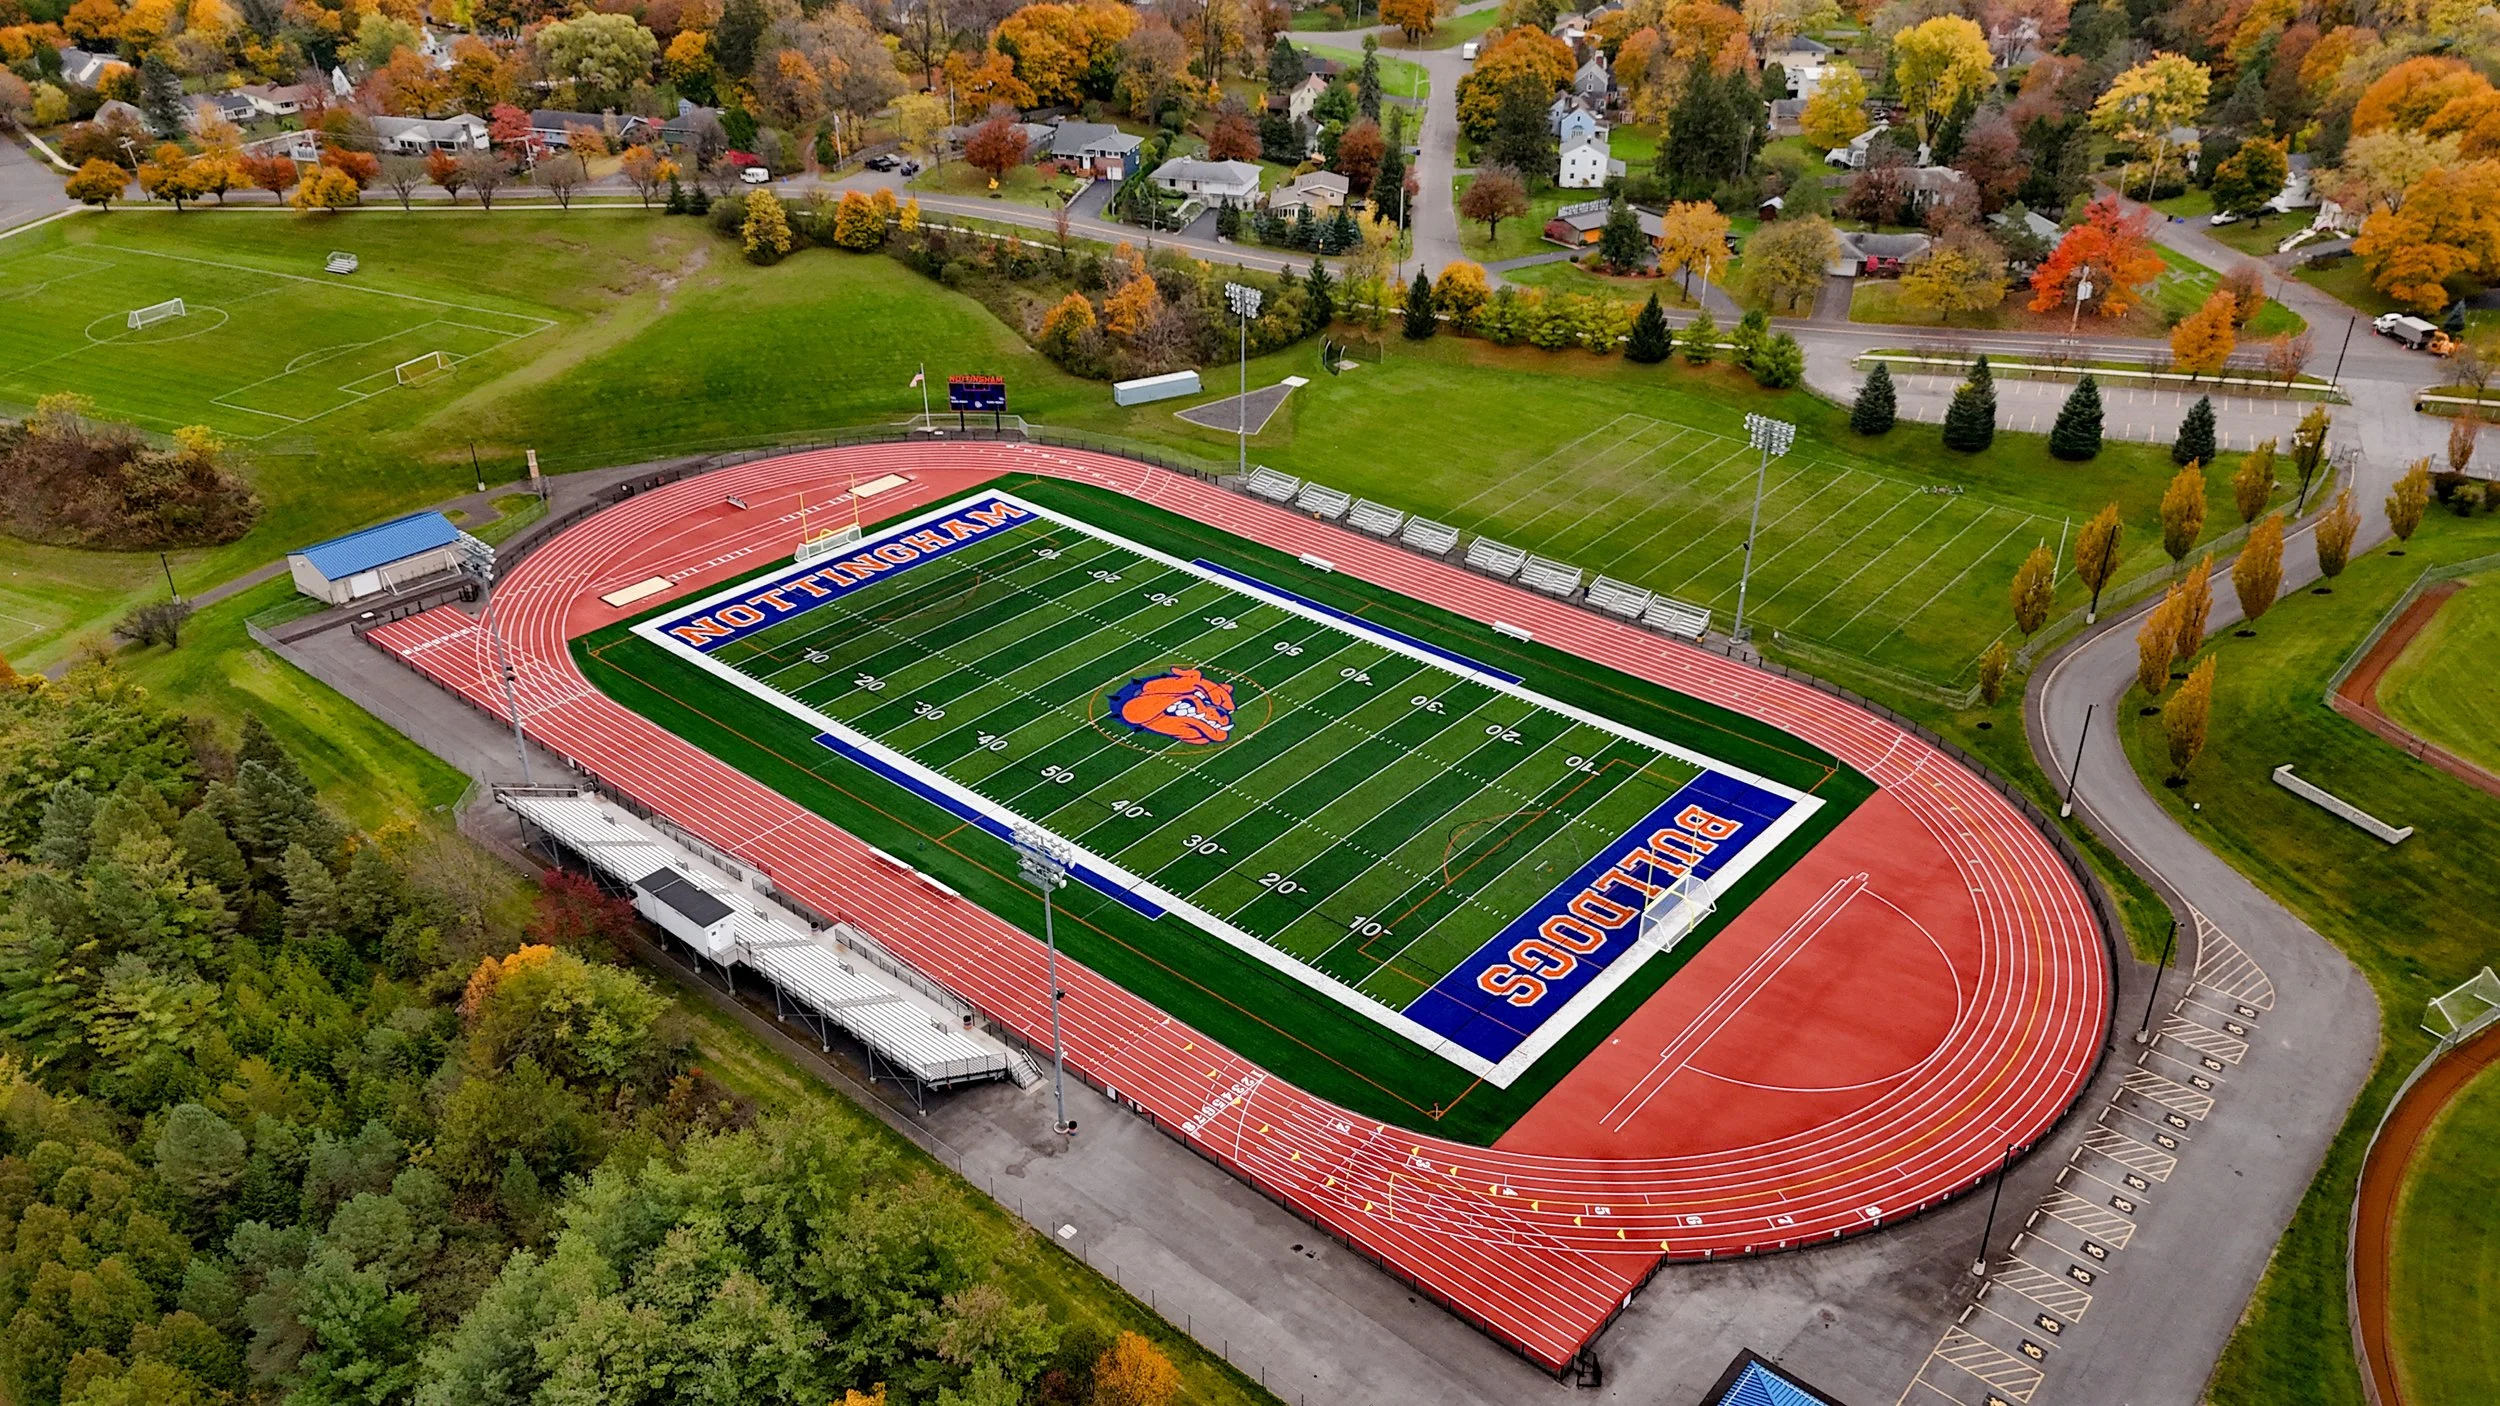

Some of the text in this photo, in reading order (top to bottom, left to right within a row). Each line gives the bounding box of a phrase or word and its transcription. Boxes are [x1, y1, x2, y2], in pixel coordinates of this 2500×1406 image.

[949, 375, 1003, 384] NOTTINGHAM
[669, 500, 1027, 649] NOTTINGHAM
[1092, 570, 1122, 584] 20
[1150, 592, 1179, 607] 30
[1210, 616, 1239, 631] 40
[806, 650, 830, 664] 10
[1273, 641, 1304, 657] 50
[854, 675, 886, 692] 20
[1339, 667, 1368, 684] 40
[914, 703, 946, 721] 30
[1410, 695, 1441, 713] 30
[977, 732, 1009, 752] 40
[1485, 724, 1519, 743] 20
[1565, 756, 1594, 773] 10
[1040, 765, 1075, 784] 50
[1110, 799, 1145, 818] 40
[1182, 834, 1219, 855] 30
[1258, 872, 1297, 895] 20
[1476, 803, 1744, 1008] BULLDOGS
[1349, 915, 1382, 937] 10
[1181, 1070, 1264, 1132] 1 2 3 4 5 6 7 8
